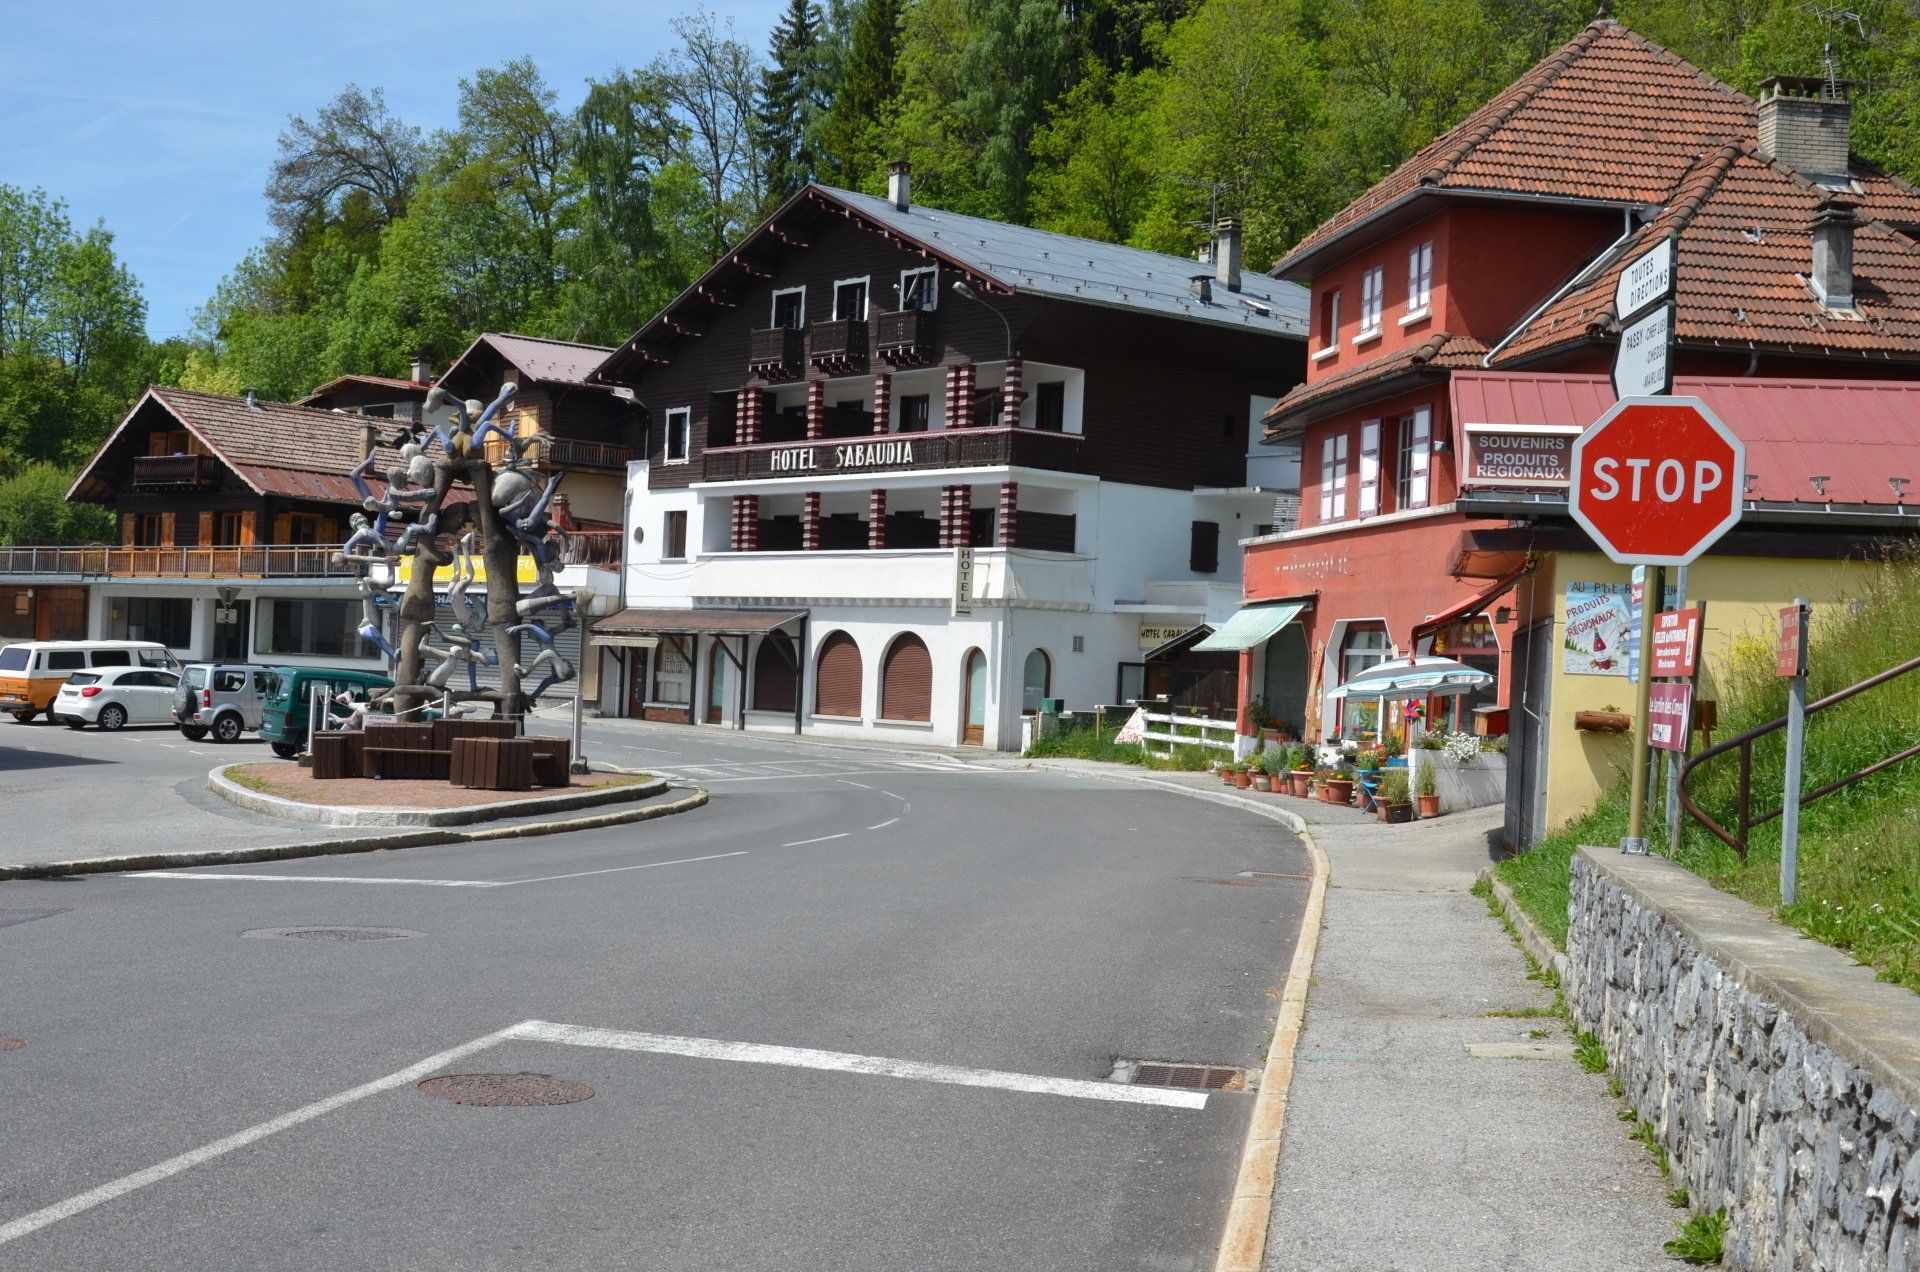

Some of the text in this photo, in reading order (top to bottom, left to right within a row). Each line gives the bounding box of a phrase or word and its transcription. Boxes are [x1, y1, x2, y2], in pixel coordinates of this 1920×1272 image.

[1631, 257, 1654, 286] TOUTES
[1630, 269, 1668, 307] DIRECTIONS
[1626, 329, 1644, 352] PASSY
[1479, 436, 1565, 450] SOUVENIRS
[771, 441, 914, 471] HOTEL SABAUDIA
[1483, 453, 1559, 467] PRODUITS
[1476, 465, 1565, 479] REGIONAUX
[1590, 457, 1723, 504] STOP
[961, 550, 971, 602] HOTEL
[1571, 582, 1585, 593] AU
[1566, 594, 1610, 619] PRODUITS
[1141, 628, 1160, 639] HOTEL
